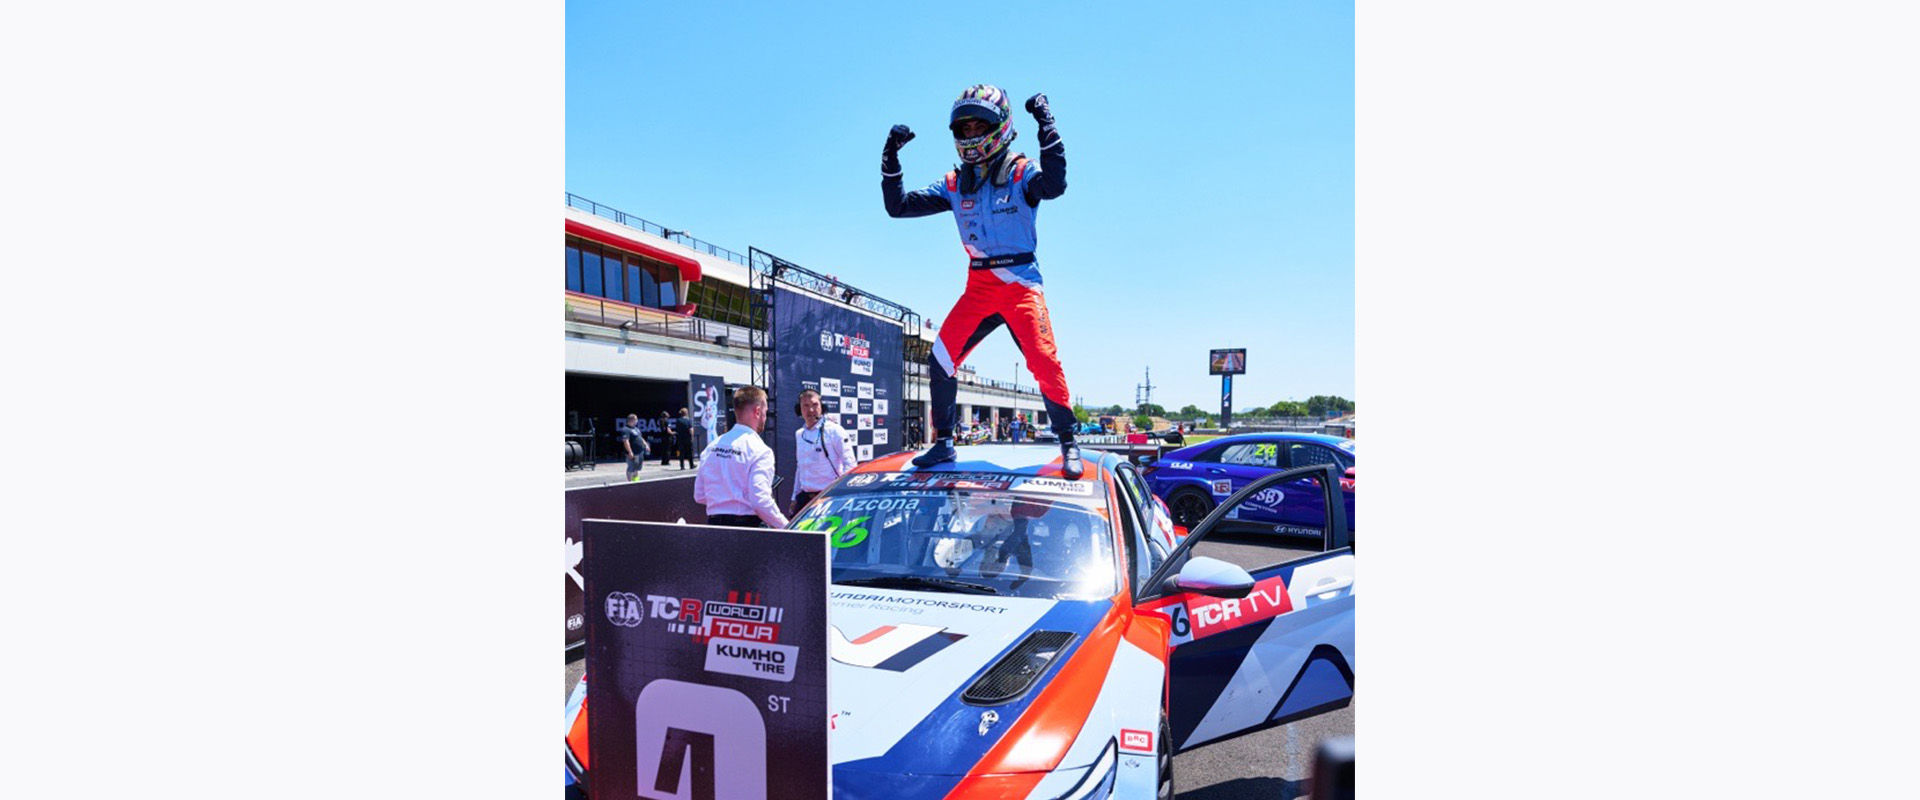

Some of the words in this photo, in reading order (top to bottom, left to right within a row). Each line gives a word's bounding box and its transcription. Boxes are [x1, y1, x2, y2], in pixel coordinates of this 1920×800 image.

[1254, 443, 1276, 457] 24
[1022, 479, 1085, 488] KUMHO
[810, 501, 832, 516] M.
[837, 498, 919, 512] Azcona
[1288, 528, 1321, 536] HYUNDAI
[646, 594, 703, 623] TCR
[708, 604, 761, 619] WORLD
[831, 592, 885, 602] UNDAI
[886, 596, 1008, 614] MOTORSPORT
[868, 603, 924, 615] Racing
[1191, 598, 1242, 628] TCR
[1242, 585, 1281, 612] TV
[716, 621, 773, 641] TOUR
[716, 644, 786, 664] KUMHO
[752, 661, 786, 674] TIRE
[768, 694, 791, 713] ST
